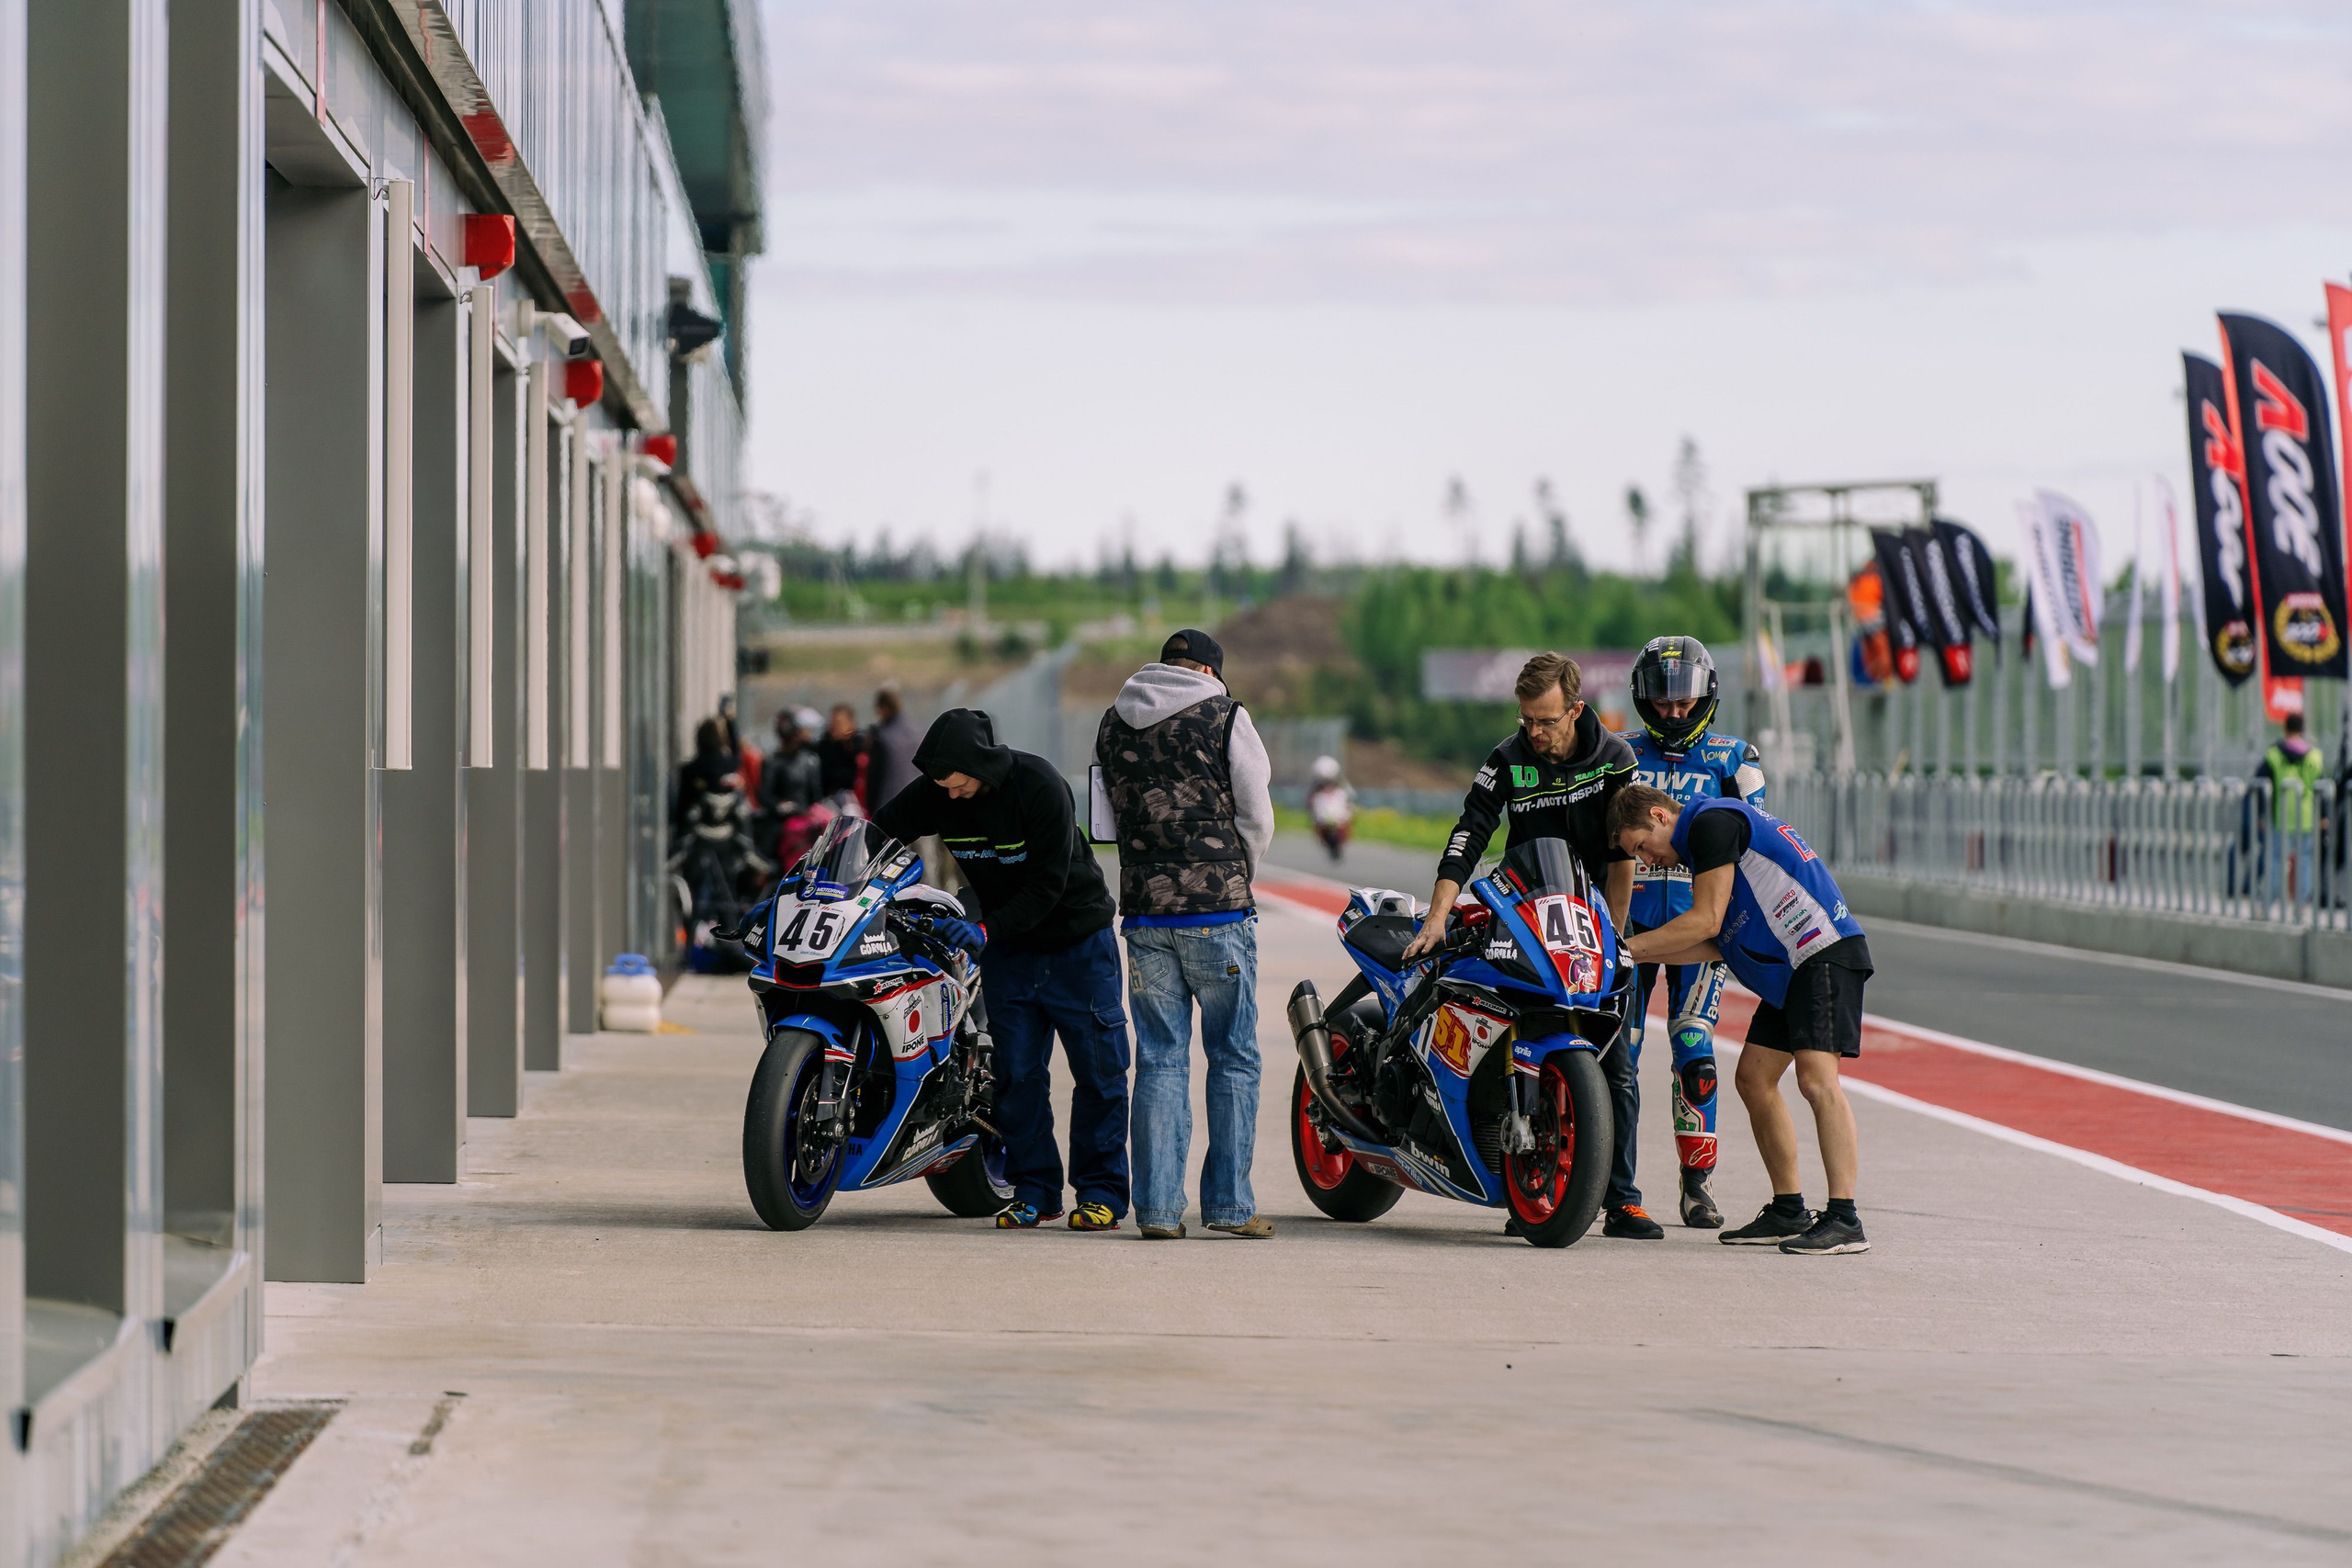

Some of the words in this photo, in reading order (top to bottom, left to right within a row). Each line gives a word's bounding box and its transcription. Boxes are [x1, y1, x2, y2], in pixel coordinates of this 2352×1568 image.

[1510, 765, 1540, 788] 10
[1574, 771, 1596, 782] TEAM
[1639, 771, 1712, 794] RWT
[816, 886, 846, 896] MOTORING
[1492, 874, 1510, 896] bwin
[778, 908, 840, 952] 45
[1546, 903, 1597, 950] 45
[1723, 909, 1750, 943] SPORT
[859, 942, 893, 955] GORILLA
[1485, 948, 1518, 960] GORILLA
[882, 976, 904, 989] ATOMIC
[902, 1035, 925, 1054] IPONE
[1434, 1005, 1465, 1066] 51
[1514, 1045, 1532, 1058] aprilia
[1395, 1155, 1423, 1186] aprilia
[1410, 1140, 1451, 1179] bwin
